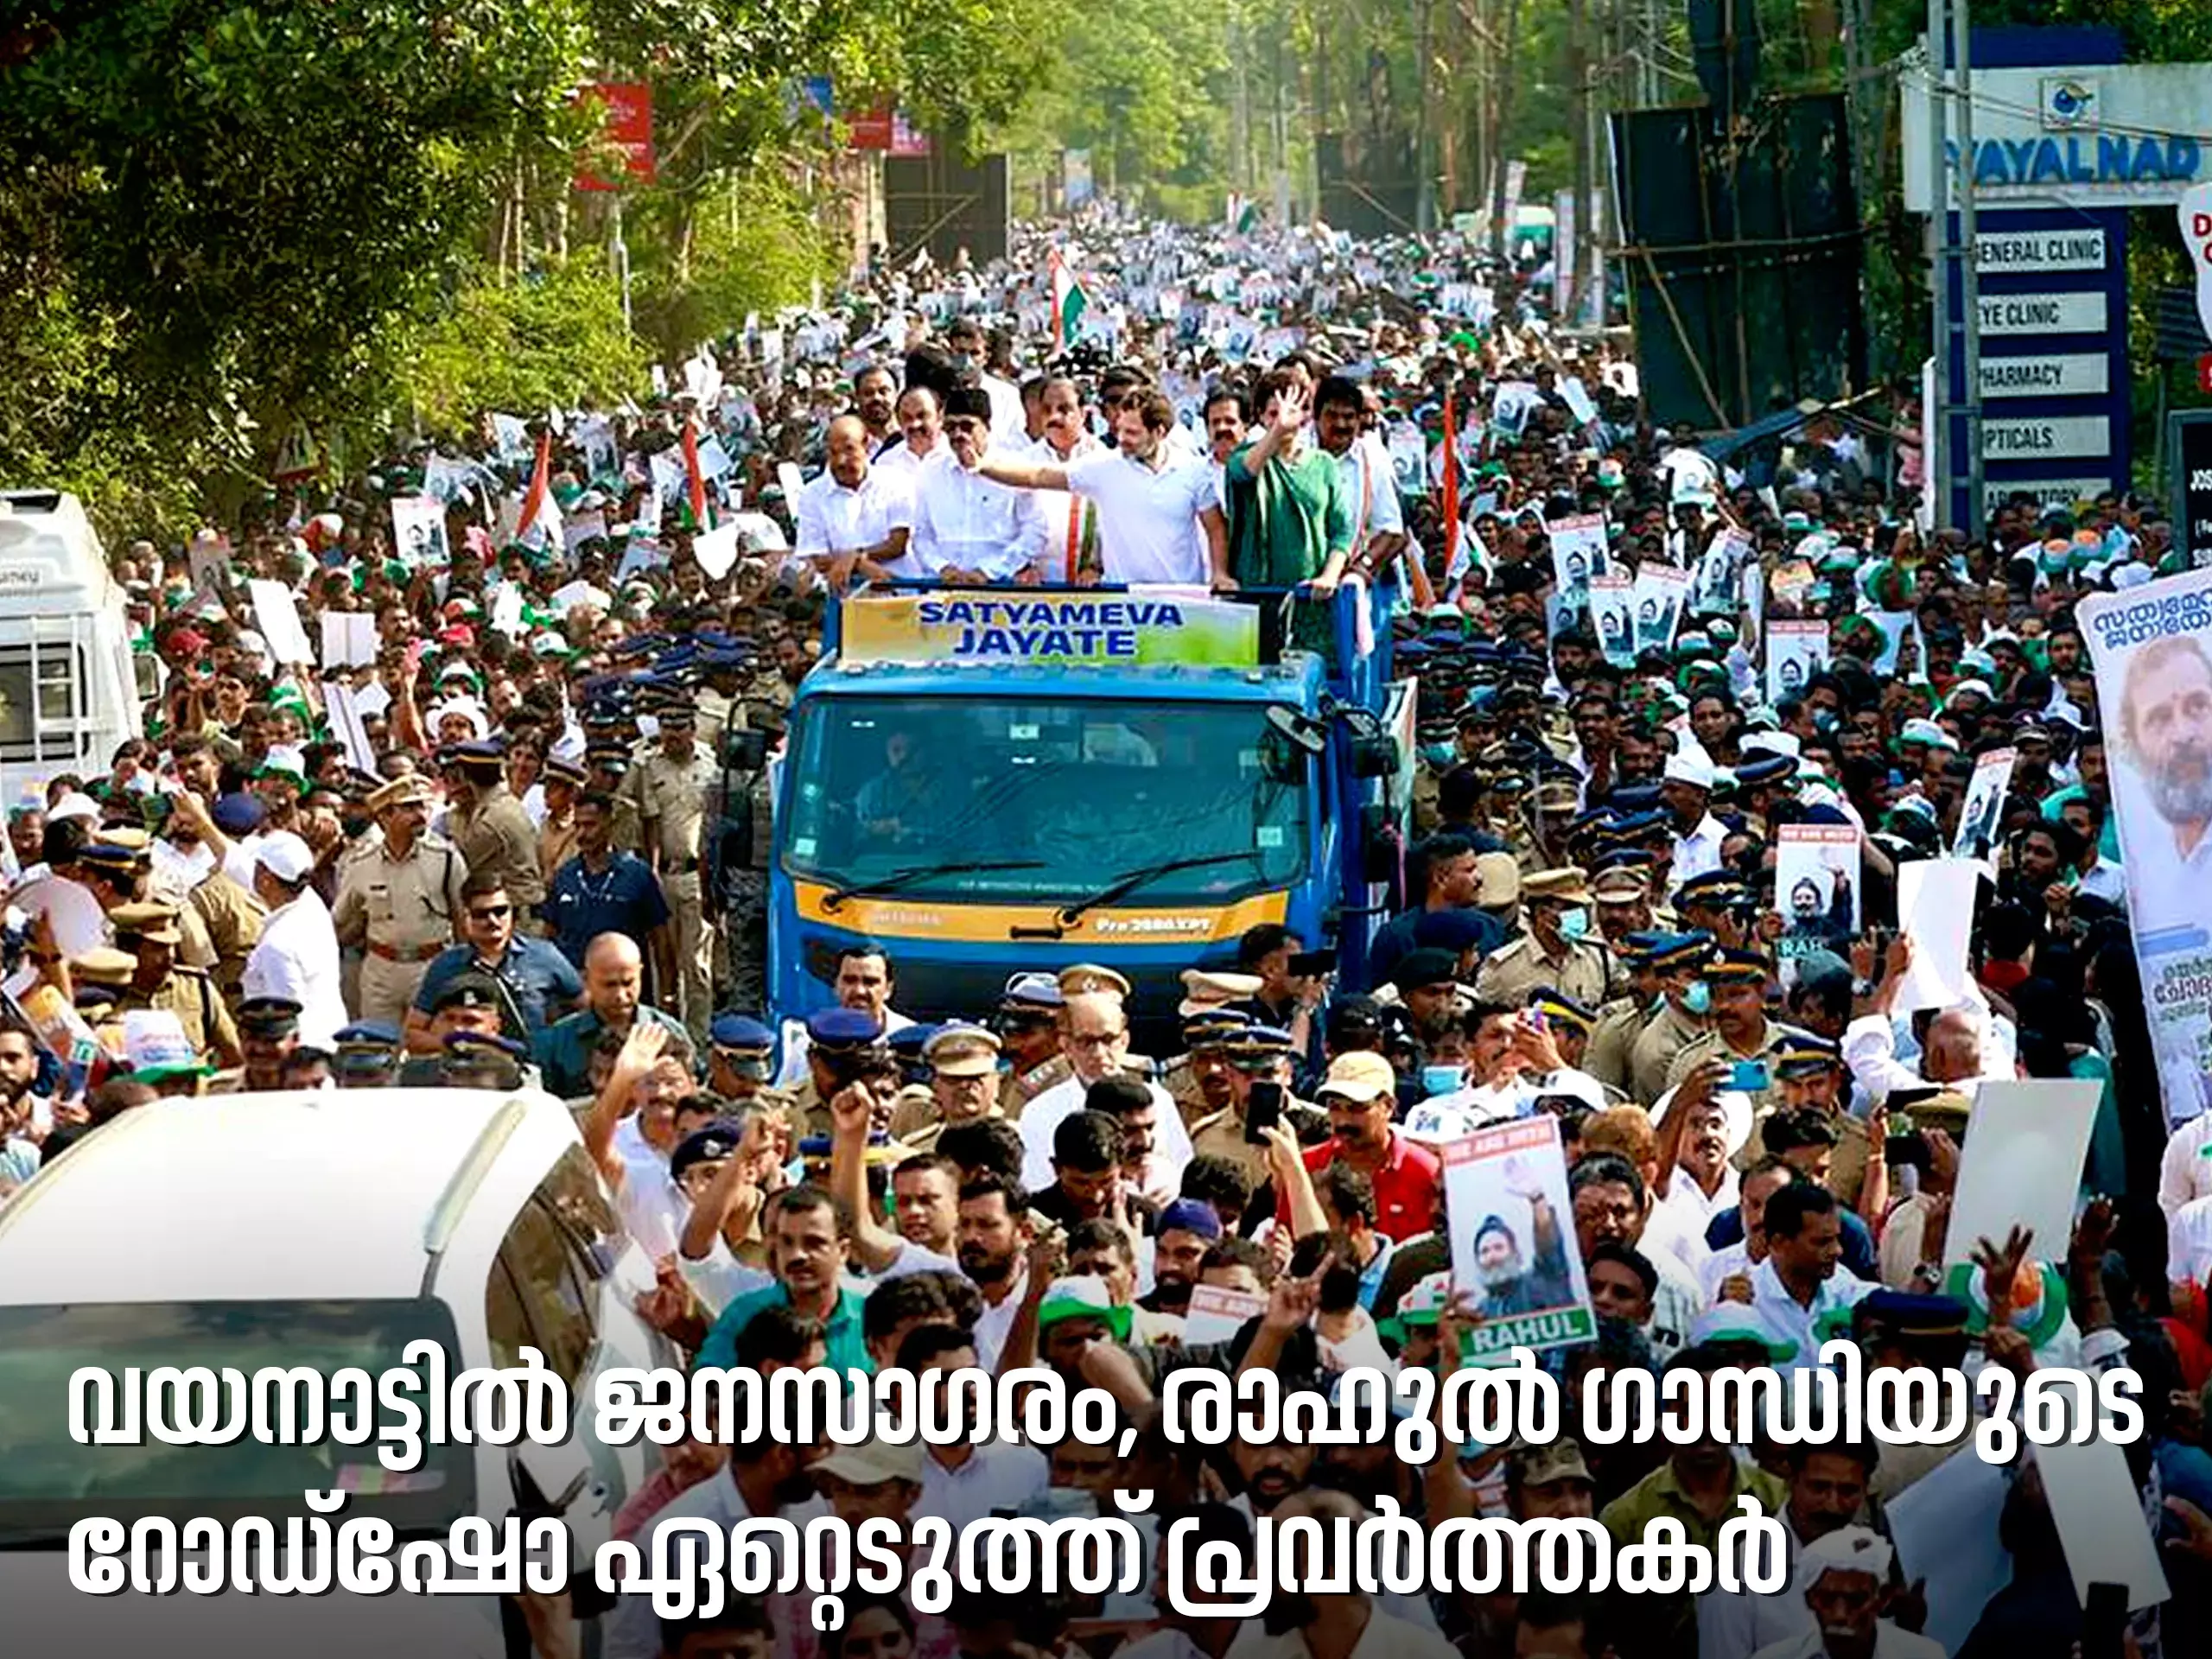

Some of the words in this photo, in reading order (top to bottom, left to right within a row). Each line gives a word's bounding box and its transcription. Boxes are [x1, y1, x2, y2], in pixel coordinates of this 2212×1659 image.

[1976, 239, 2044, 263] ENERAL
[2047, 238, 2102, 261] CLINIC
[1978, 303, 2003, 326] YE
[2005, 302, 2062, 326] CLINIC
[1986, 426, 2054, 449] PTICALS
[918, 601, 1184, 626] SATYAMEVA
[953, 629, 1136, 655] JAYATE
[1471, 1312, 1583, 1353] RAHUL
